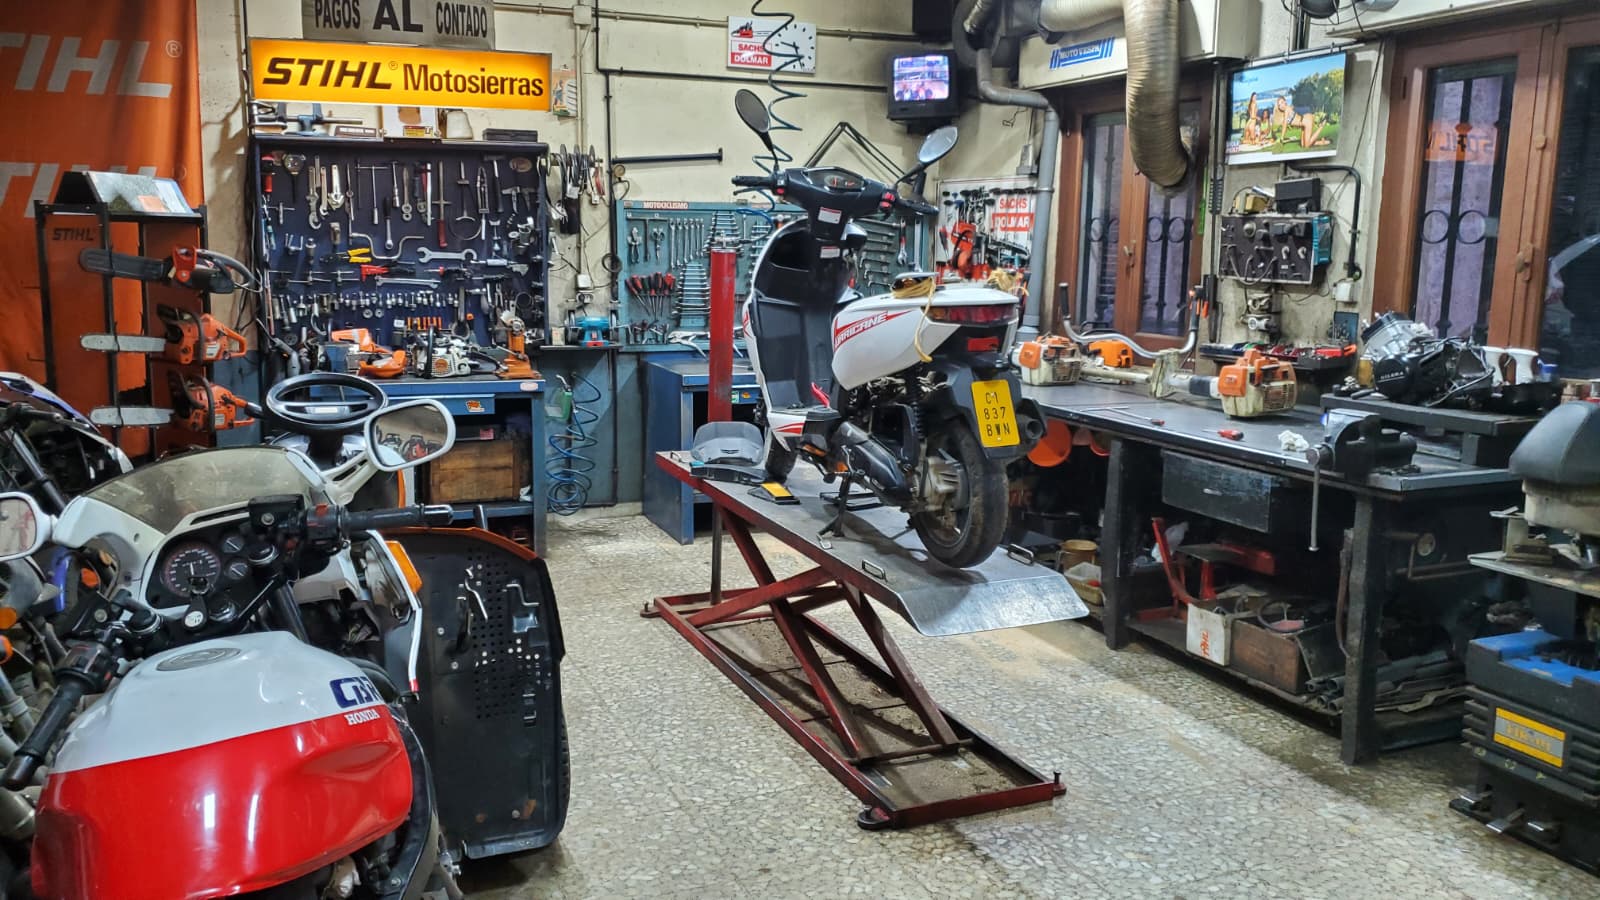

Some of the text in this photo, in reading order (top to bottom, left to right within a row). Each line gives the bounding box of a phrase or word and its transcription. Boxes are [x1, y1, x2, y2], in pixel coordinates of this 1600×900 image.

[315, 0, 488, 38] PAGOS AL CONTADO
[738, 43, 764, 52] SACHS
[734, 55, 768, 65] DOLMAR
[262, 57, 544, 97] STIHL Motosierras
[999, 198, 1028, 209] SACHS
[996, 216, 1030, 228] DOLMAR
[53, 228, 94, 241] STIHL
[984, 406, 1006, 420] 837
[986, 422, 1010, 436] BWN
[344, 709, 380, 725] HONDA
